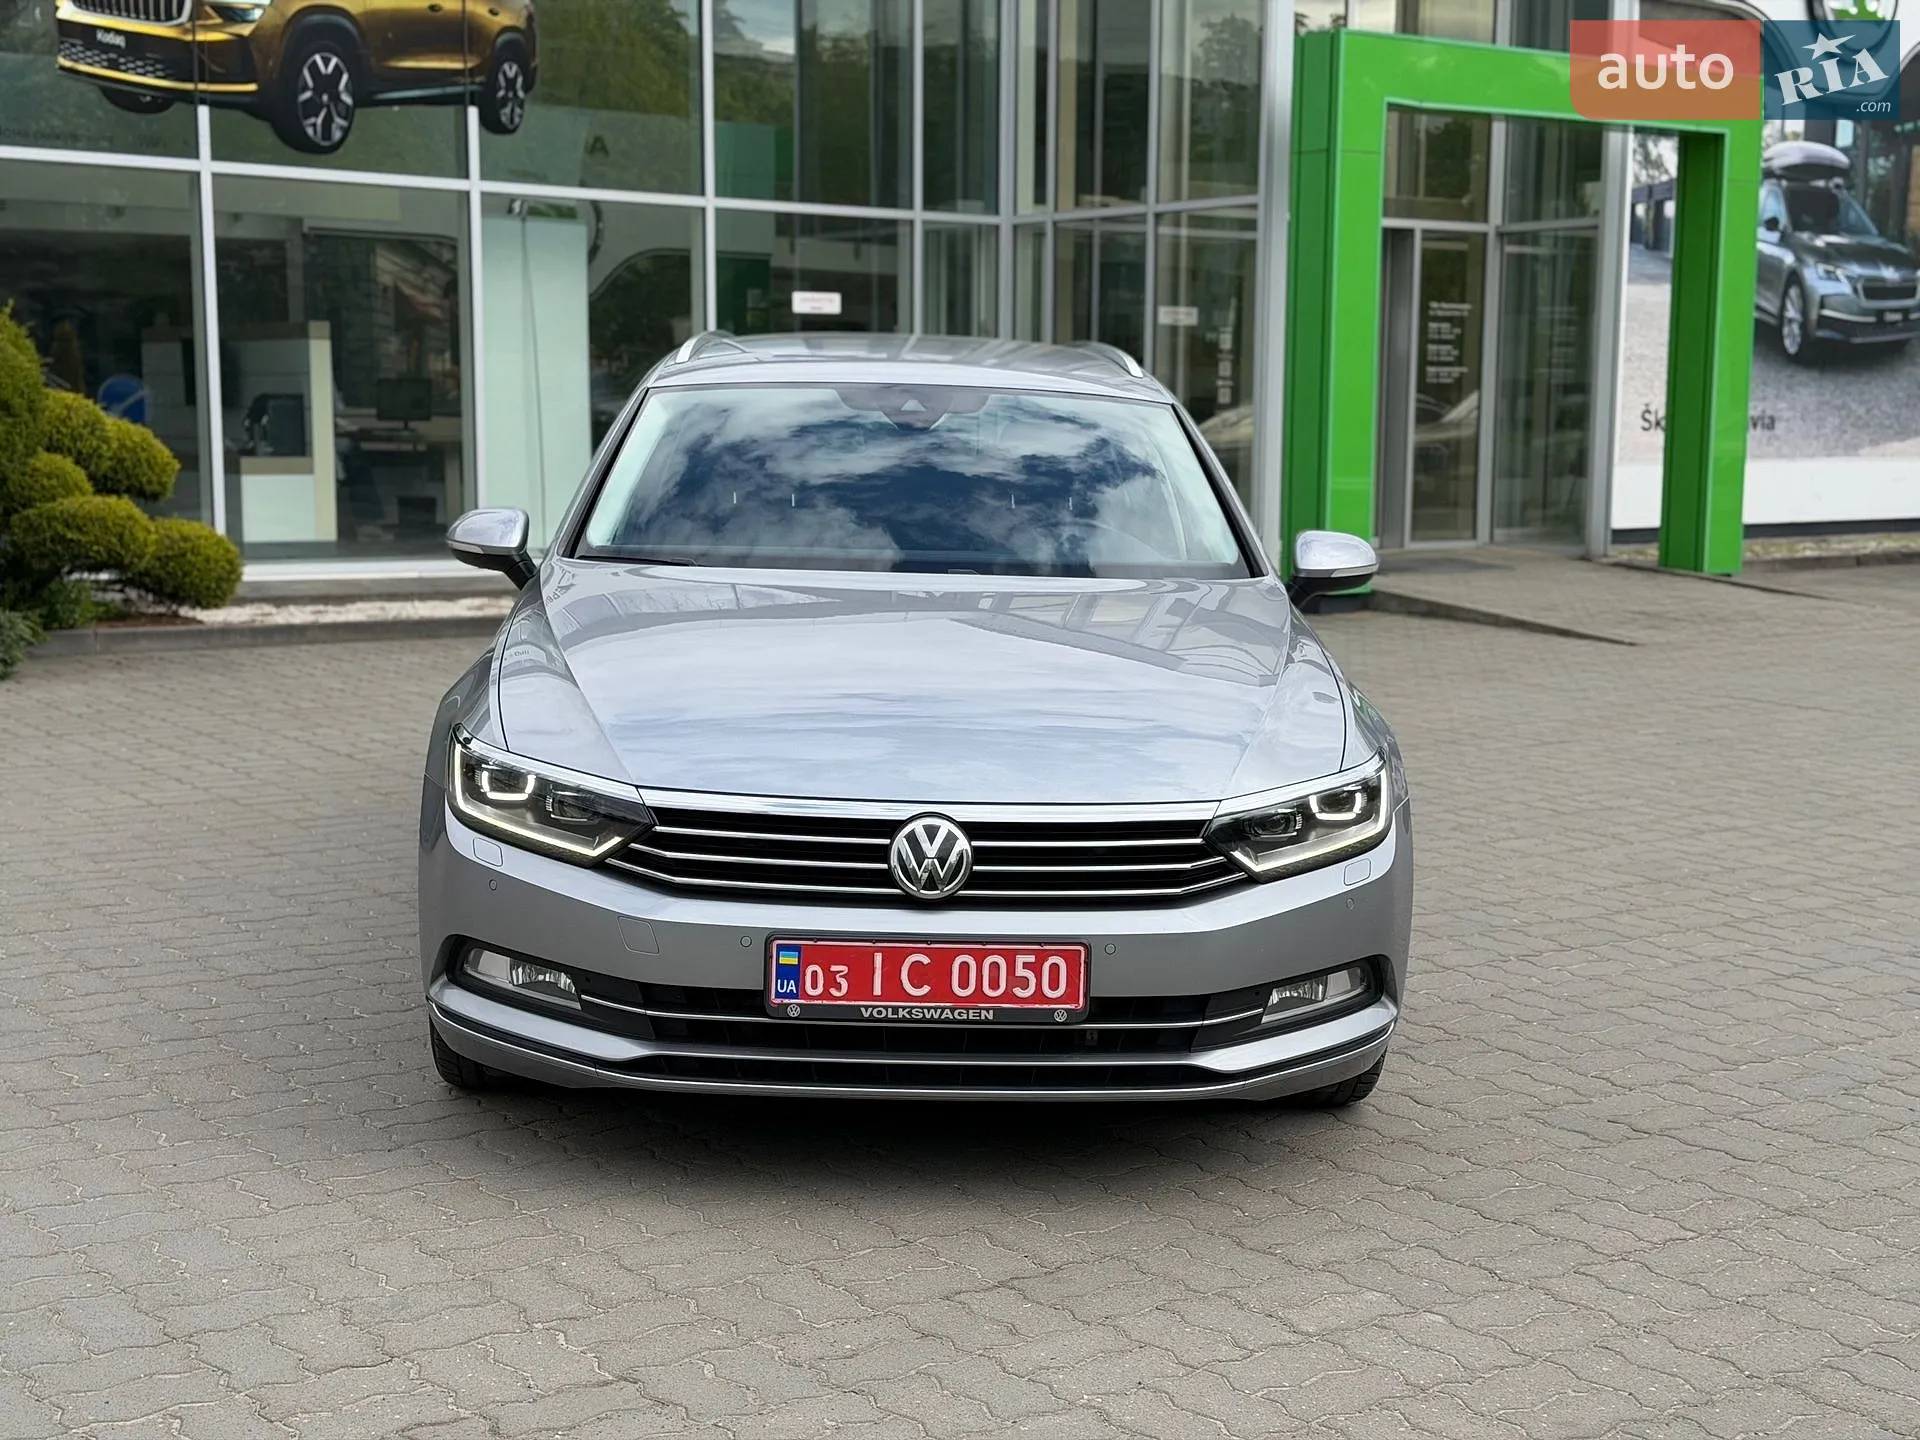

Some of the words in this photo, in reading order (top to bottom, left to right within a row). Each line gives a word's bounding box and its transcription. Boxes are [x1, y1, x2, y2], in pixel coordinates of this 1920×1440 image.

[777, 979, 797, 995] UA
[804, 964, 849, 998] 03
[951, 954, 1068, 999] 0050
[860, 1006, 994, 1021] VOLKSWAGEN
